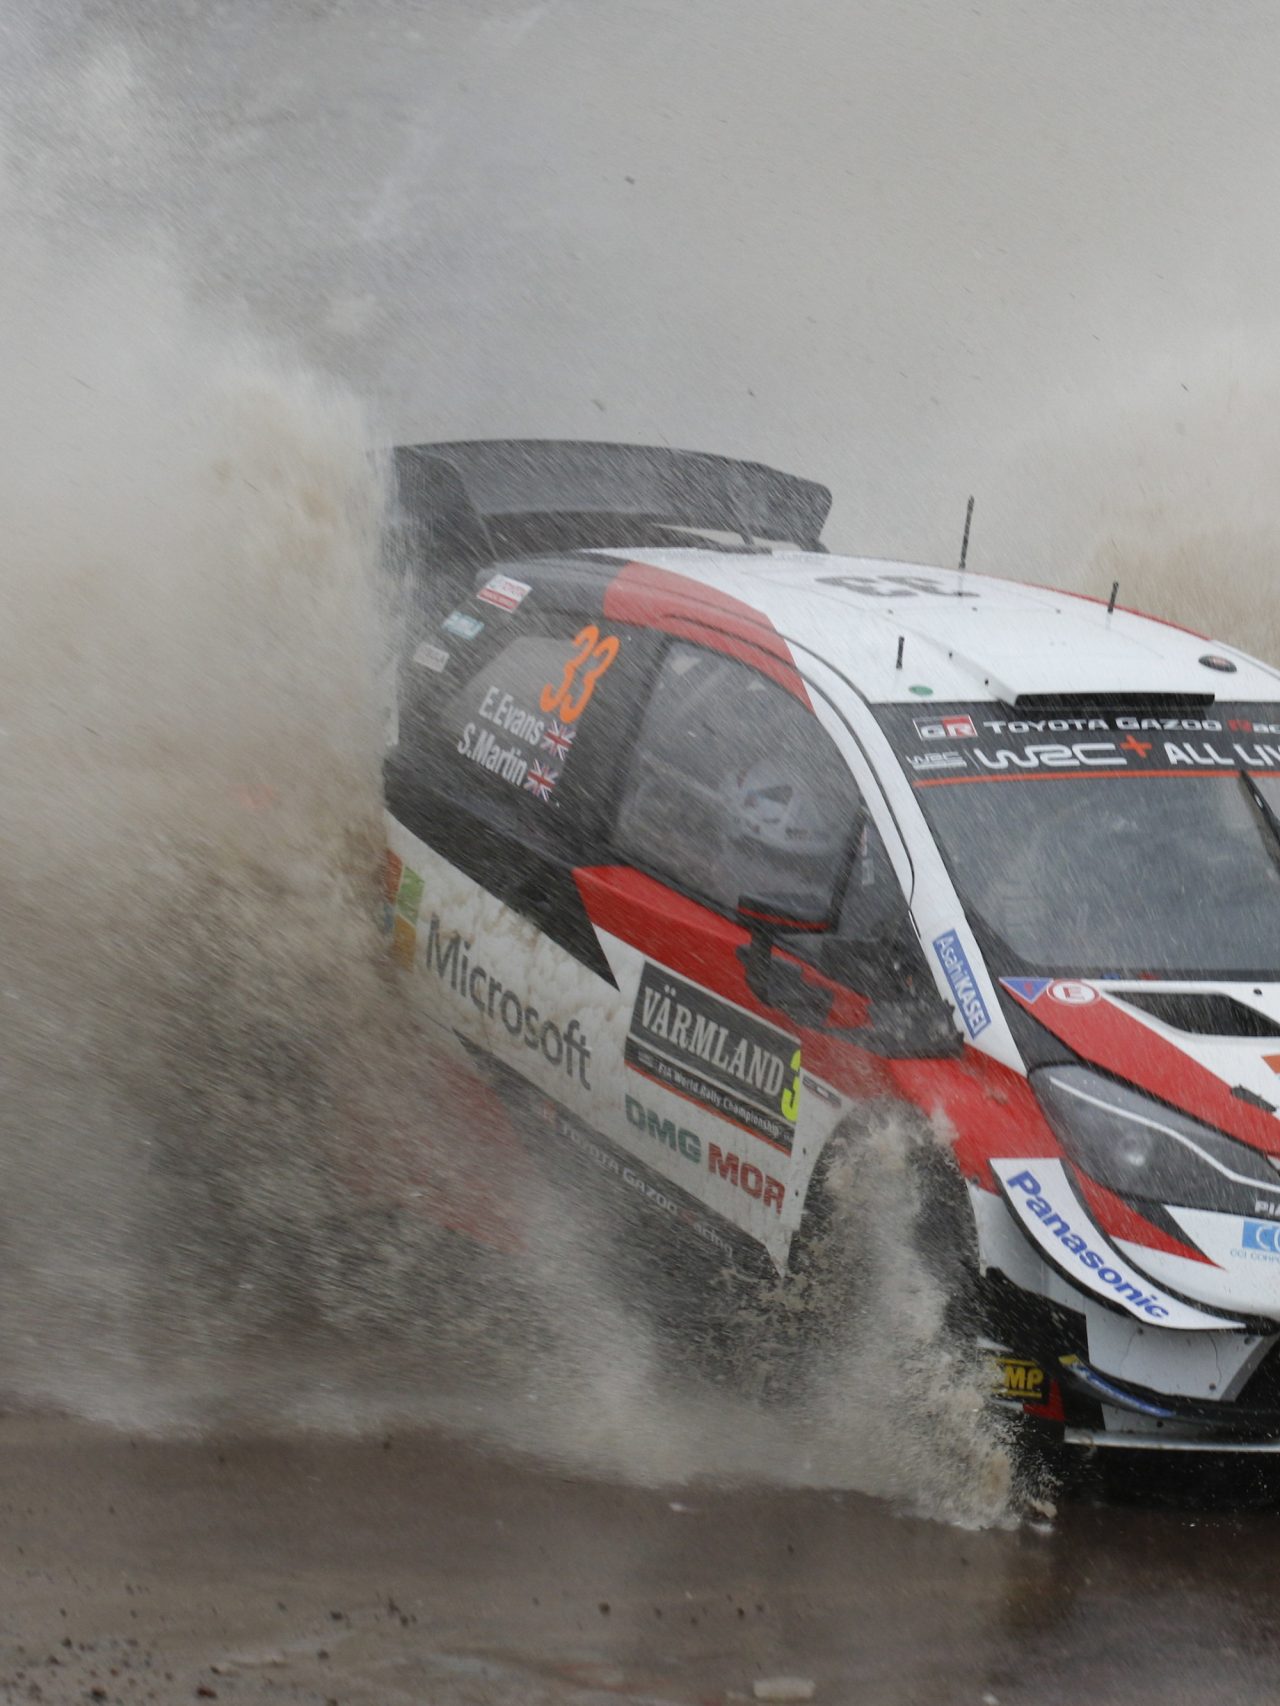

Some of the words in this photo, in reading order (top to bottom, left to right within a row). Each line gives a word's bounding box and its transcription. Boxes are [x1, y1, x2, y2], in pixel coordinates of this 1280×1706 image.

[540, 624, 619, 724] 33
[478, 685, 545, 746] E.Evans
[983, 718, 1110, 734] TOYOTA
[1115, 716, 1222, 732] GAZOO
[457, 722, 528, 786] S.Martin
[1164, 742, 1235, 765] ALL
[426, 912, 592, 1091] Microsoft
[641, 984, 785, 1097] VÄRMLAND
[625, 1093, 702, 1164] DMG
[1006, 1170, 1169, 1319] Panasonic
[1003, 1366, 1044, 1390] MP
